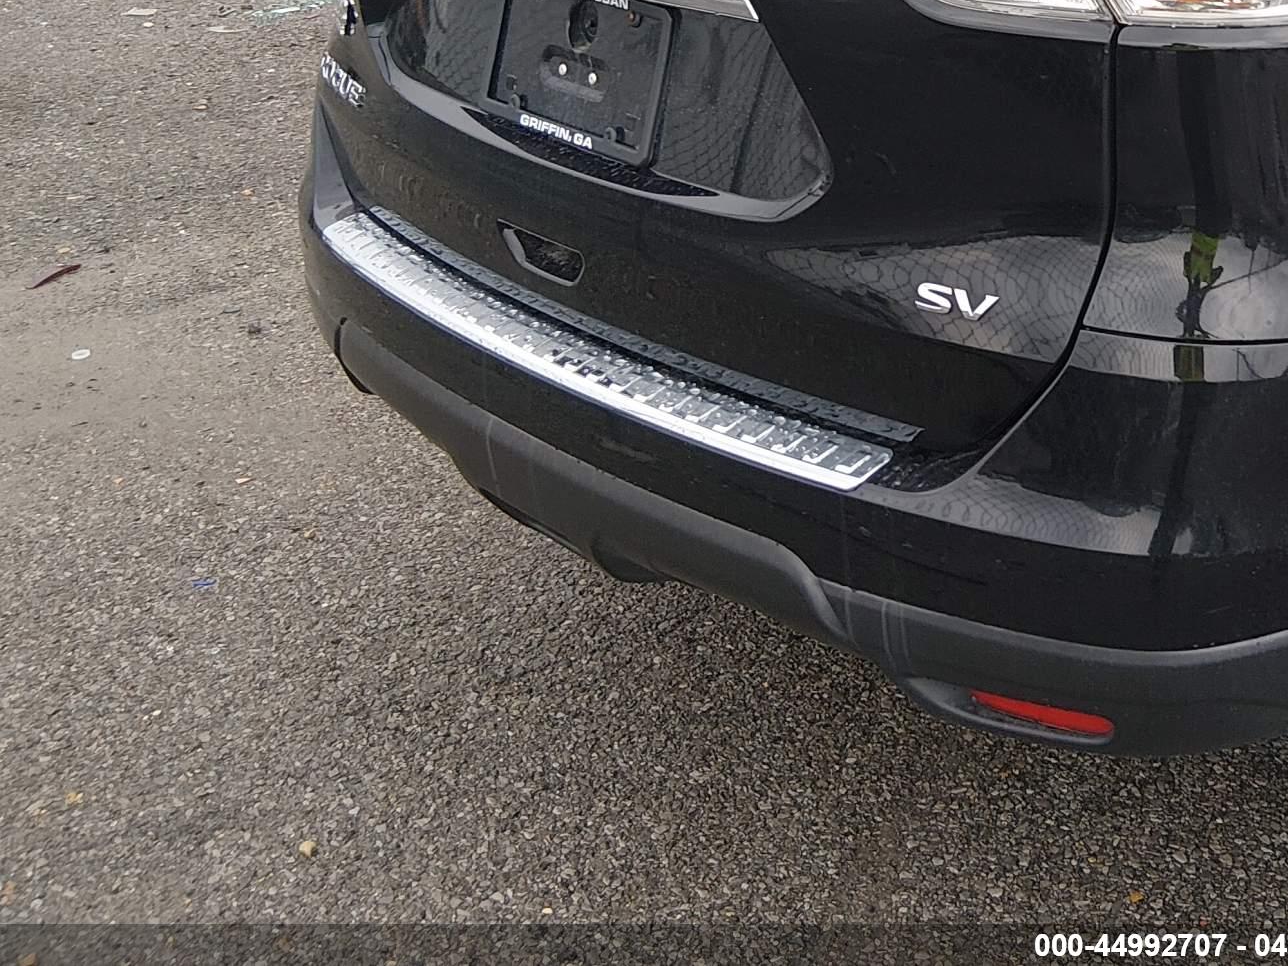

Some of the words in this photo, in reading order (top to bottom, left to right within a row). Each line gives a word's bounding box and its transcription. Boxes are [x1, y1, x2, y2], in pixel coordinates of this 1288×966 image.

[520, 114, 572, 142] GRIFFIN,
[573, 133, 593, 150] GA
[914, 282, 1000, 321] SV
